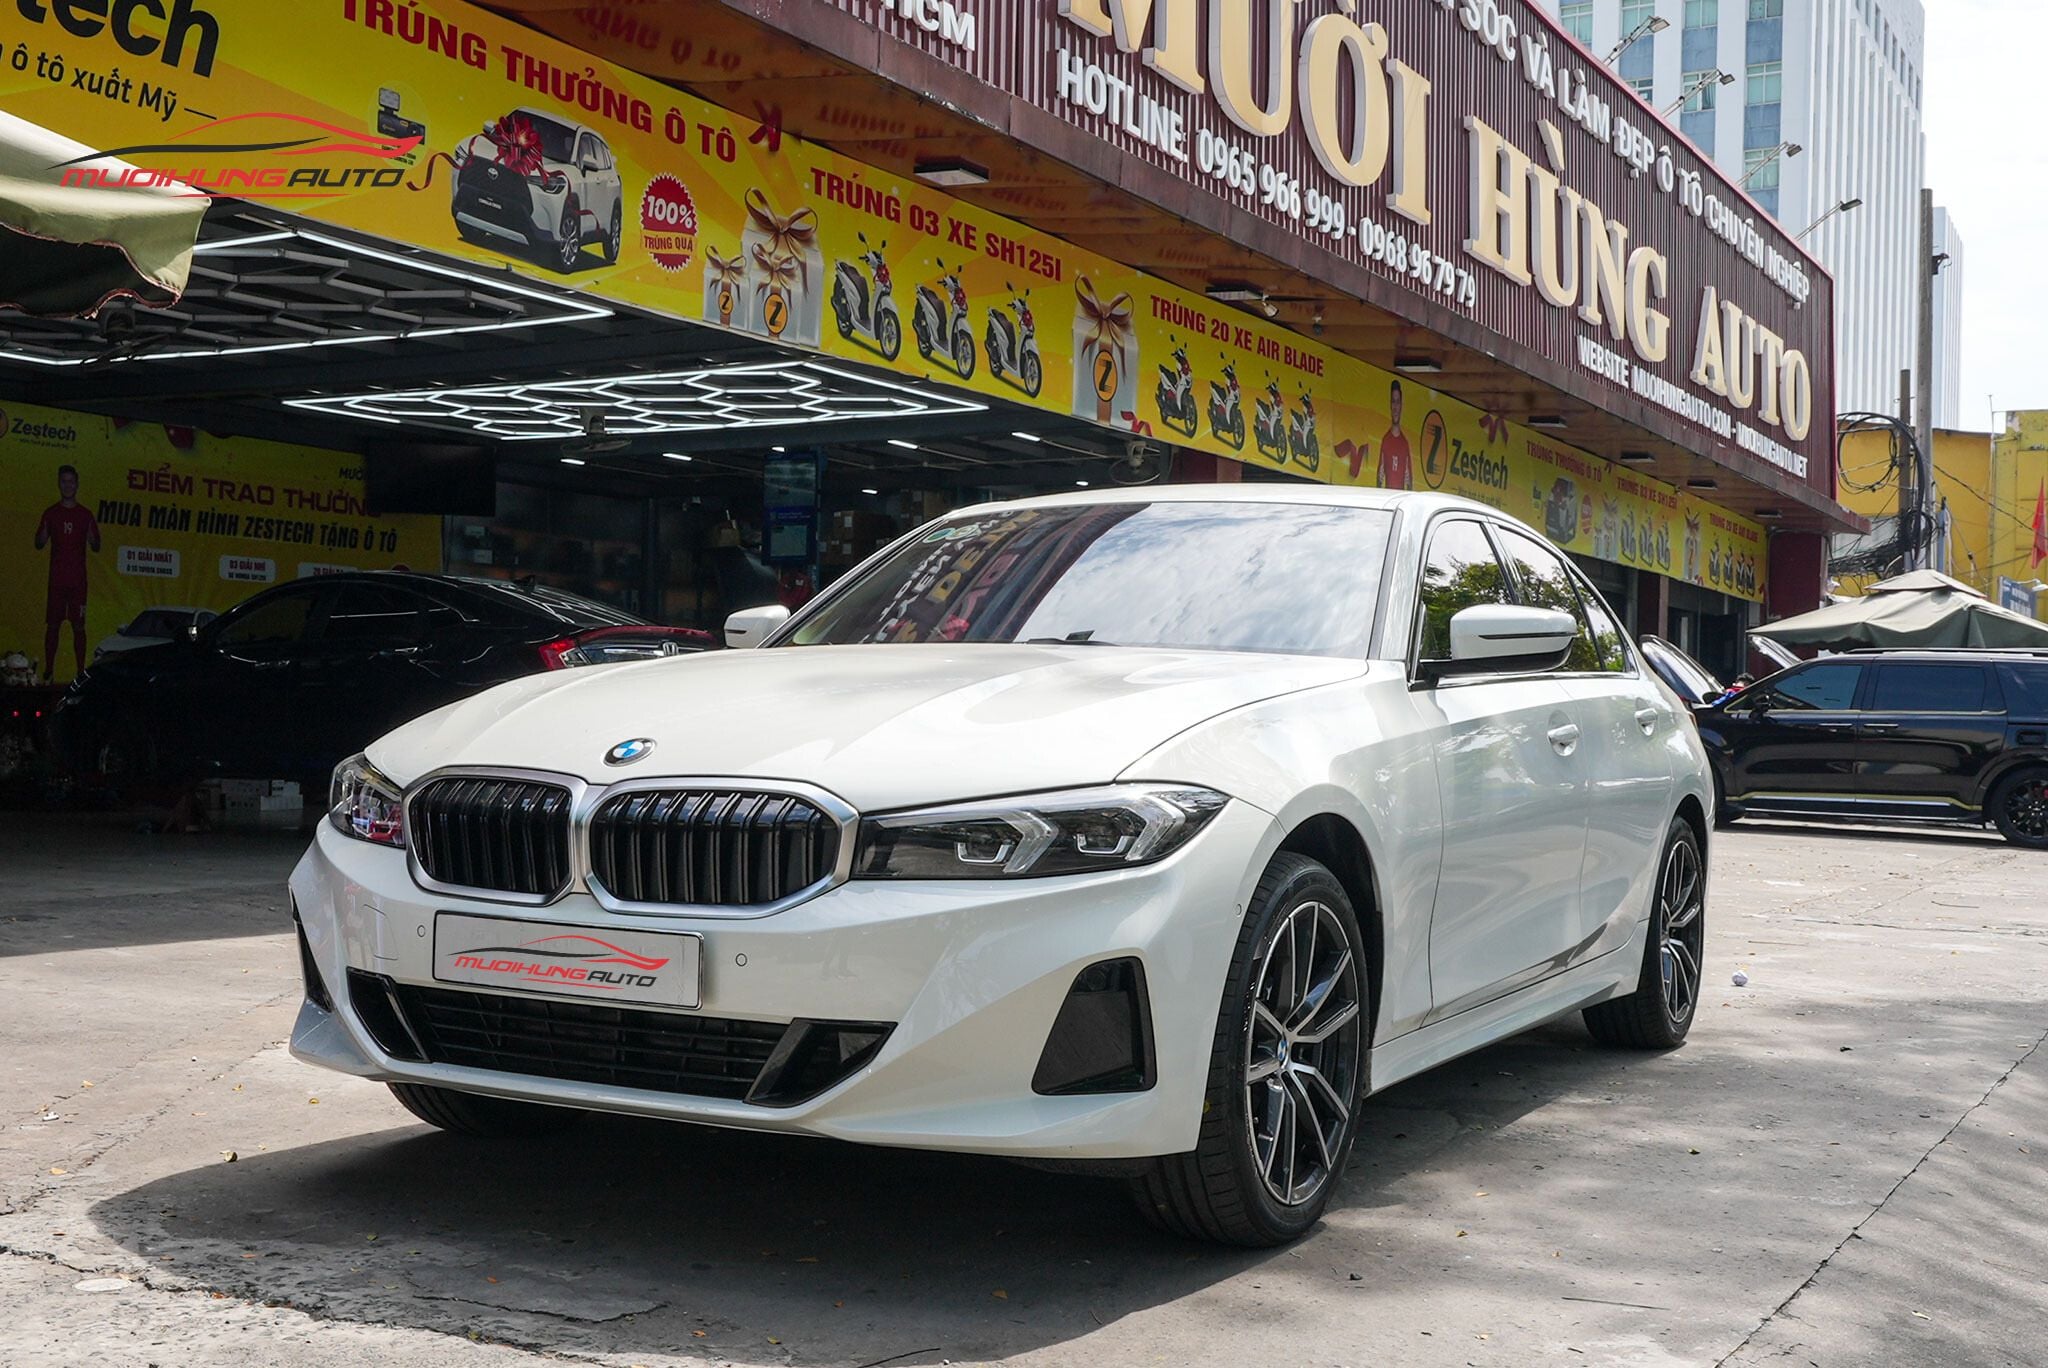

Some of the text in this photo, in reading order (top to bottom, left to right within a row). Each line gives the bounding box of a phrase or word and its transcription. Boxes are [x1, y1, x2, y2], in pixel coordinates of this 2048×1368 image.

[11, 42, 178, 122] ô tô xuất Mỹ
[501, 45, 652, 134] THƯỞNG
[664, 105, 687, 145] Ô
[696, 122, 737, 163] TÔ
[1197, 128, 1256, 196] 0965
[1259, 164, 1301, 219] 966
[1305, 188, 1345, 240] 999
[1520, 32, 1555, 99] VÀ
[1558, 68, 1610, 143] LÀM
[1612, 116, 1655, 179] ĐẸP
[1656, 145, 1674, 192] Ô
[1676, 171, 1703, 217] TÔ
[1704, 194, 1764, 269] CHUYÊN
[1764, 245, 1810, 310] NGHIỆP
[647, 195, 693, 229] 100%
[810, 167, 901, 224] TRÚNG
[909, 204, 940, 237] 03
[948, 216, 977, 251] XE
[644, 235, 673, 250] TRÚNG
[1463, 115, 1669, 362] HÙNG
[1690, 285, 1811, 441] AUTO
[1151, 295, 1325, 378] TRÚNG 20 XE AIR BLADE
[1577, 335, 1629, 388] WEBSITE
[11, 418, 76, 441] Zestech
[127, 463, 193, 496] ĐIỂM
[202, 478, 274, 505] TRAO
[1450, 438, 1508, 490] Zestech
[97, 500, 397, 552] MUA MÀN HÌNH ZESTECH TẶNG Ô TÔ
[454, 955, 658, 988] MUOIHUNGAUTO
